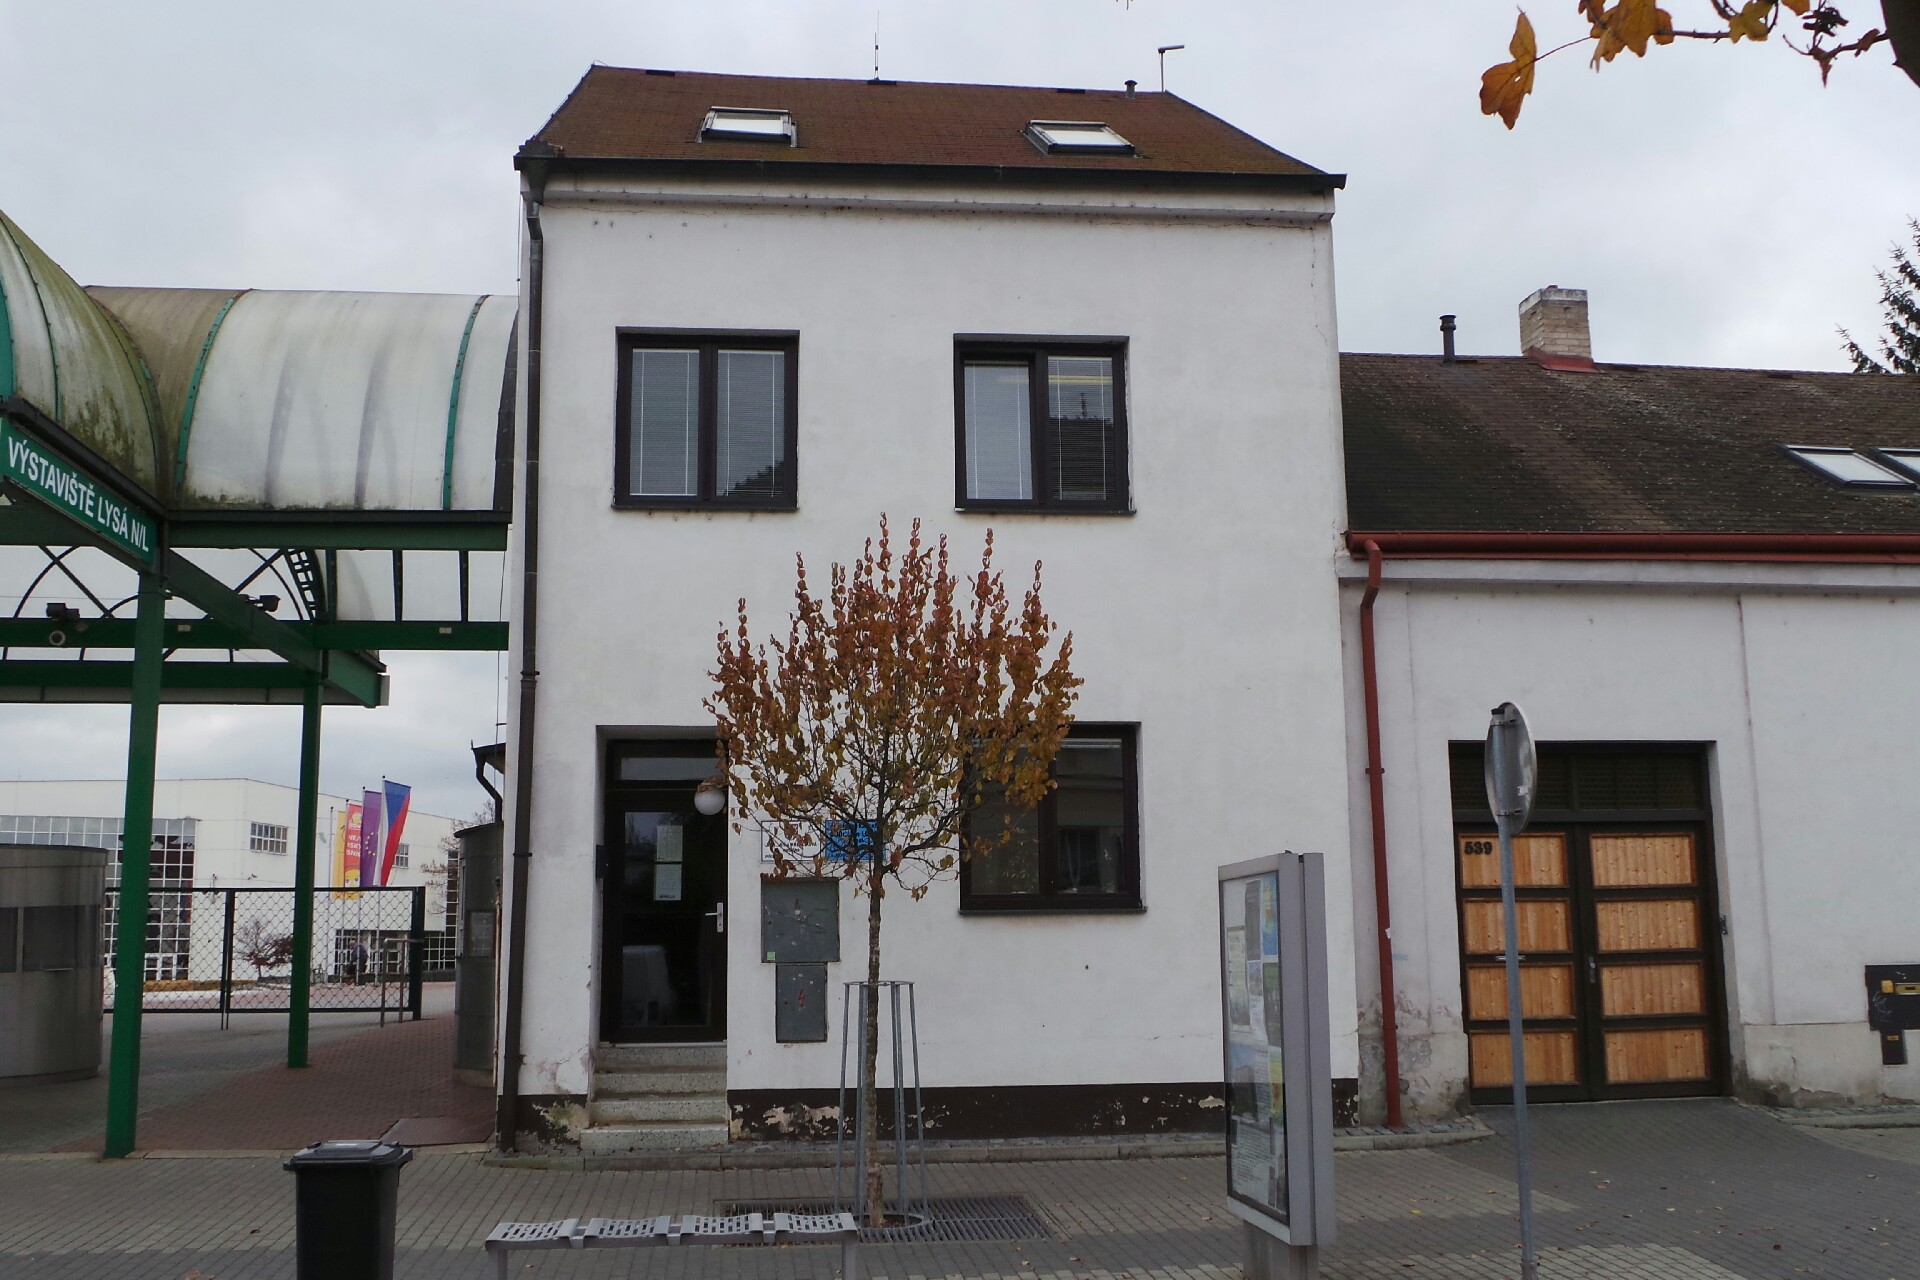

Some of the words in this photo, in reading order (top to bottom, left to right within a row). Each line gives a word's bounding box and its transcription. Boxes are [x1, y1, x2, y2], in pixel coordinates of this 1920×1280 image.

[8, 436, 95, 518] VÝSTAVIŠTĚ
[97, 496, 128, 539] LYSÁ
[131, 518, 149, 552] N/L
[1464, 841, 1493, 855] 539
